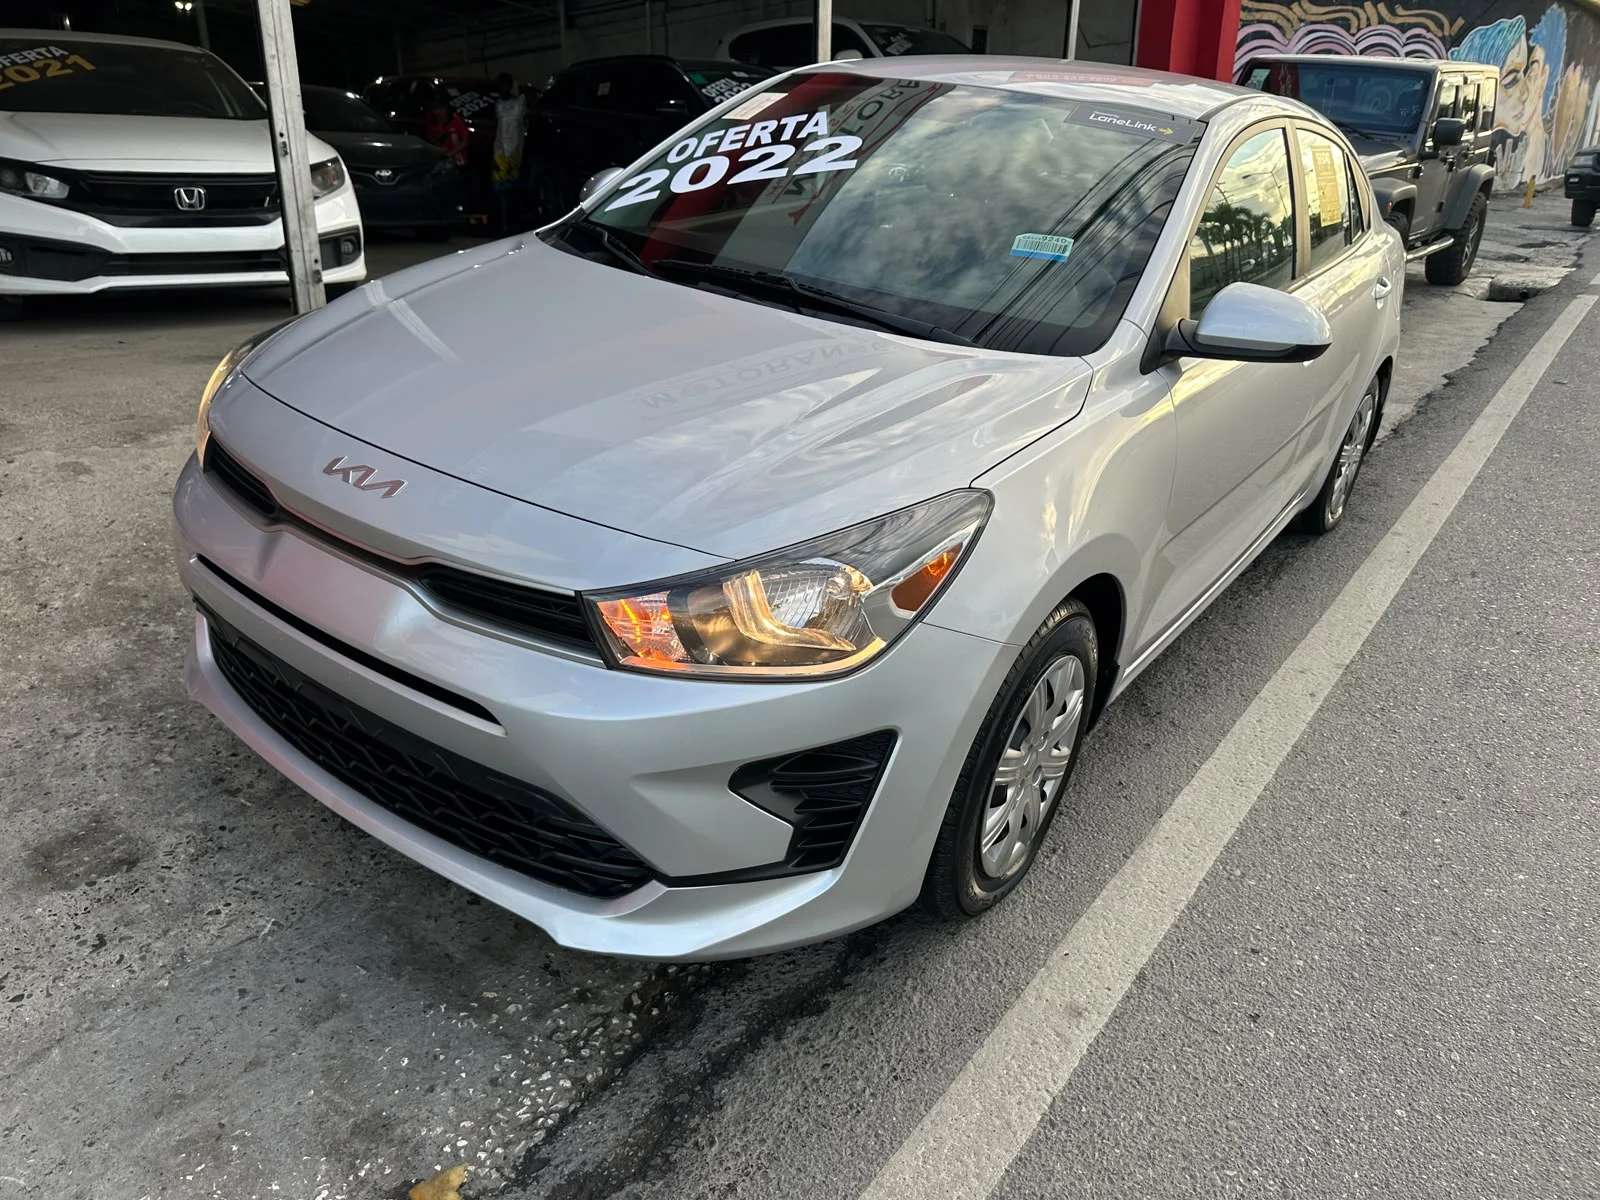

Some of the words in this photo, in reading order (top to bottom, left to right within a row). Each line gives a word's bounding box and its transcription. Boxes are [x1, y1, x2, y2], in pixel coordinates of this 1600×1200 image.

[0, 46, 69, 68] FERTA
[666, 111, 829, 164] OFERTA
[1088, 113, 1157, 132] LaneLink
[604, 135, 863, 212] 2022
